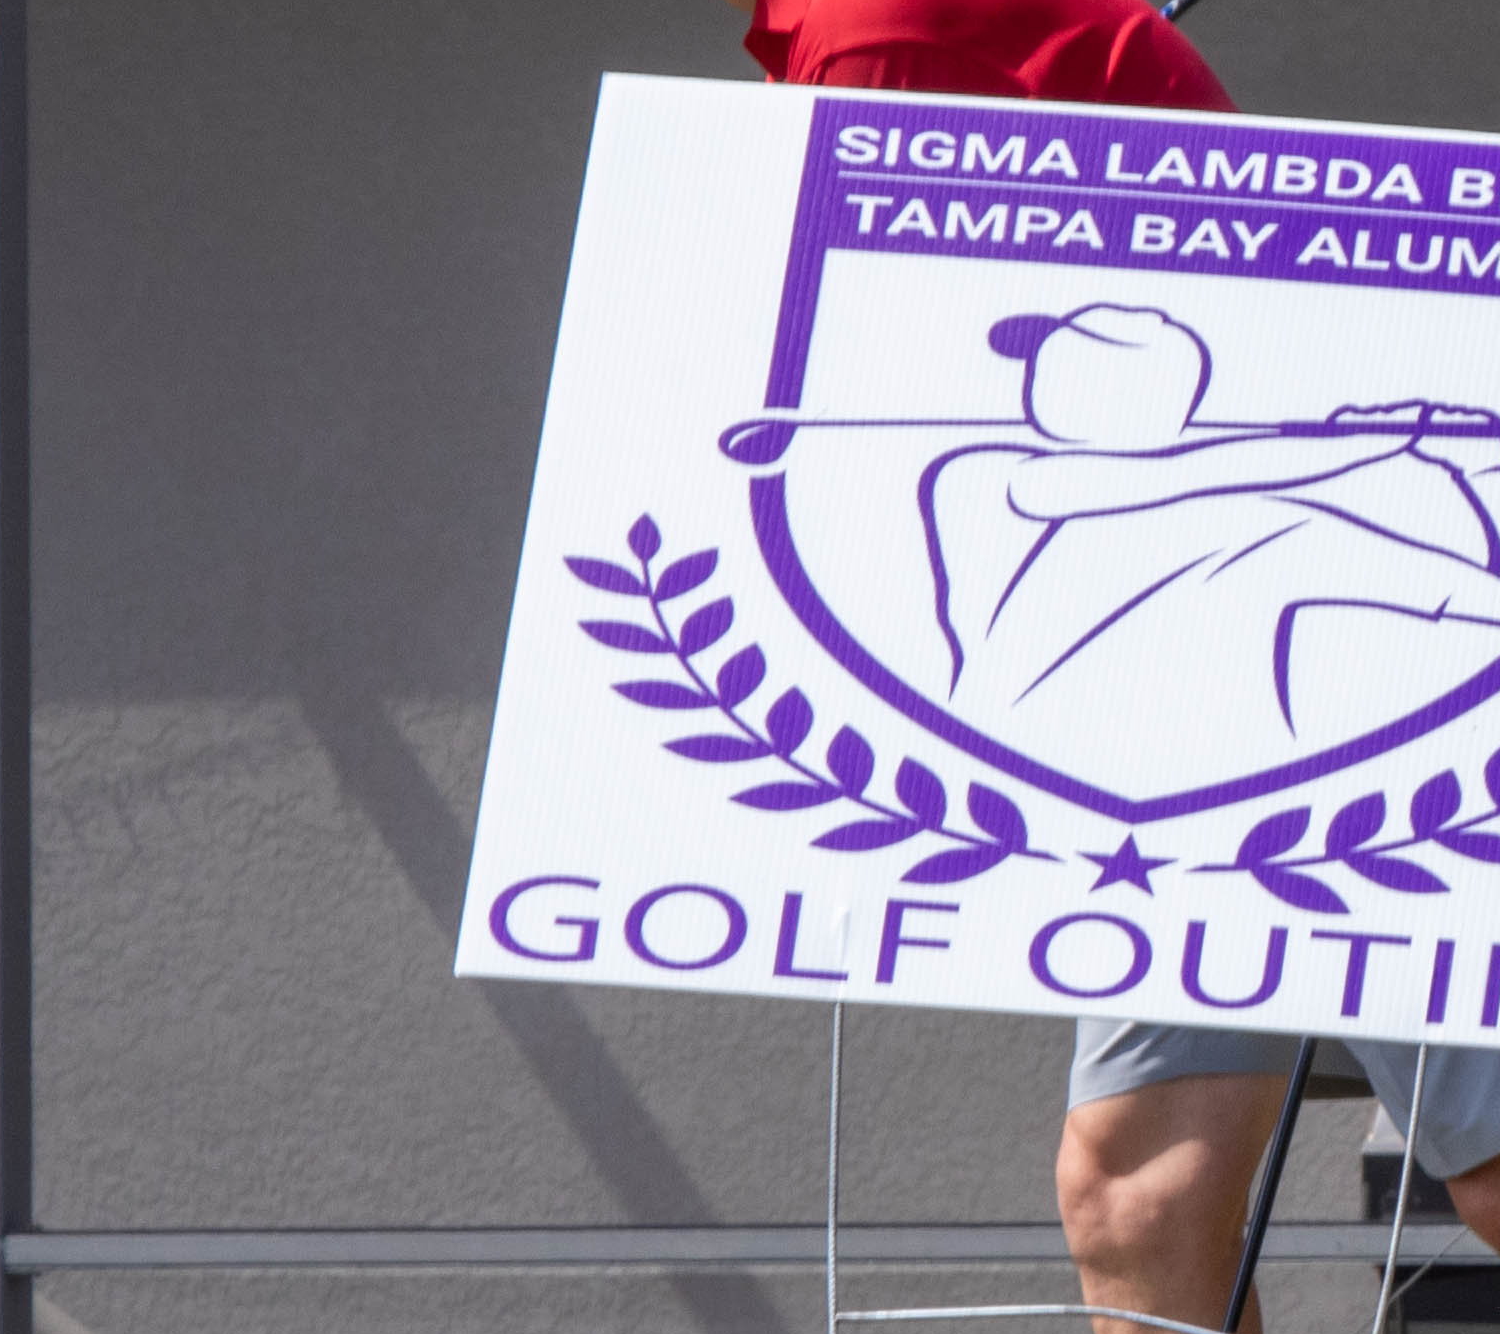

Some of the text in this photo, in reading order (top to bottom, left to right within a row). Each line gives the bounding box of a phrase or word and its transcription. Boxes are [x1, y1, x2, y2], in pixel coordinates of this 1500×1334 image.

[835, 123, 1081, 181] SIGMA
[1103, 141, 1424, 205] LAMBDA
[844, 192, 1106, 252] TAMPA
[1128, 212, 1280, 262] BAY
[488, 874, 961, 985] GOLF
